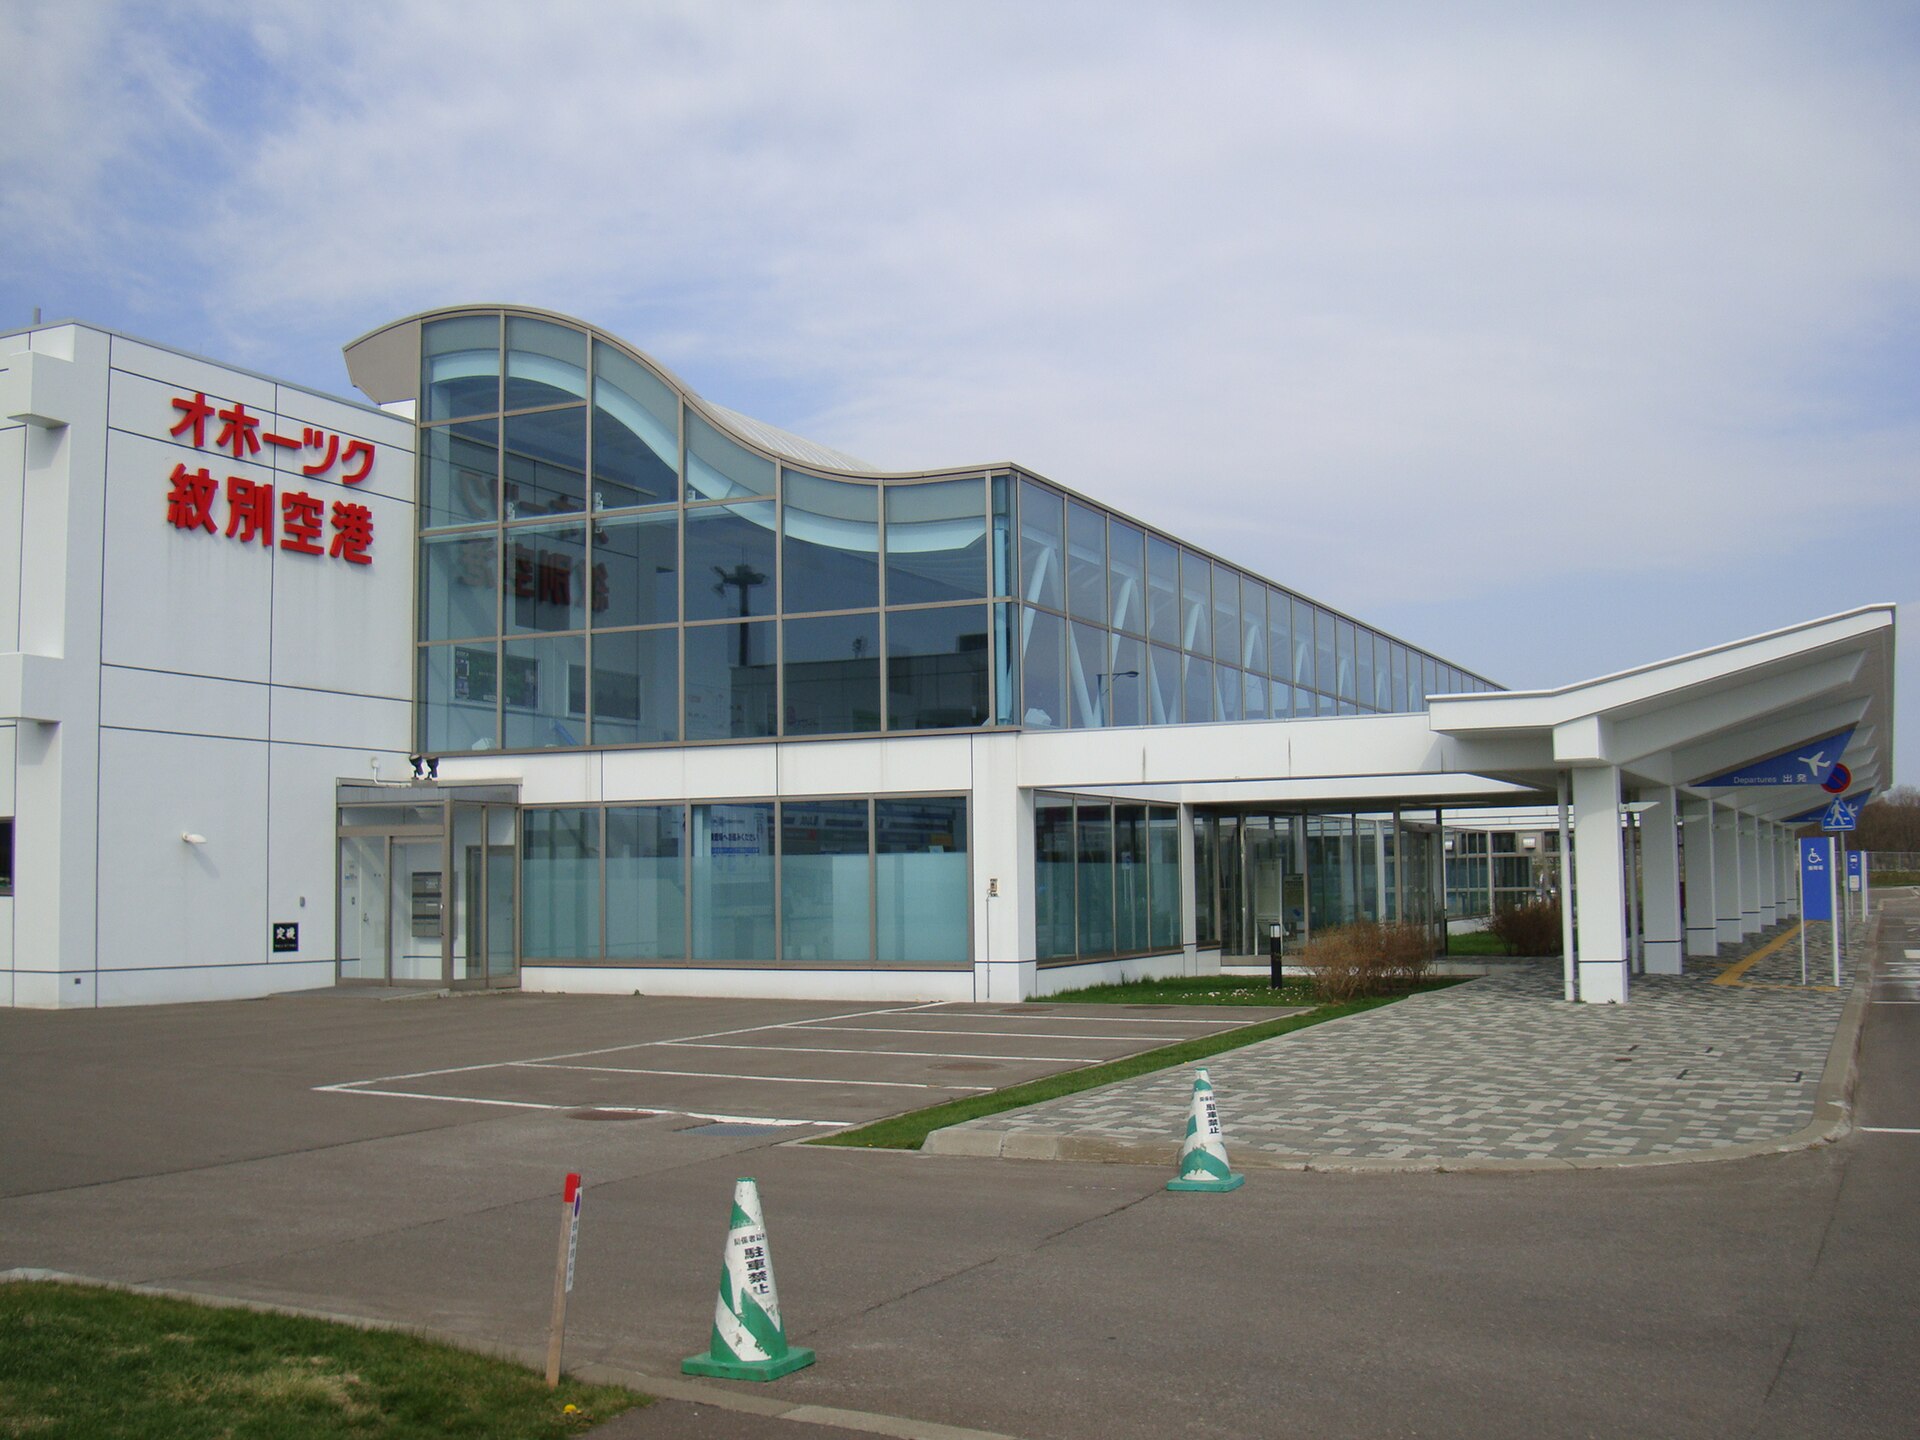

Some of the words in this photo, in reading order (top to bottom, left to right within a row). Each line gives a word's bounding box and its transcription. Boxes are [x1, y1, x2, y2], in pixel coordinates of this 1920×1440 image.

[169, 392, 376, 484] オホーツク
[167, 463, 374, 565] 紋別空港
[1733, 776, 1777, 784] Departures
[744, 1246, 770, 1295] 駐車禁止
